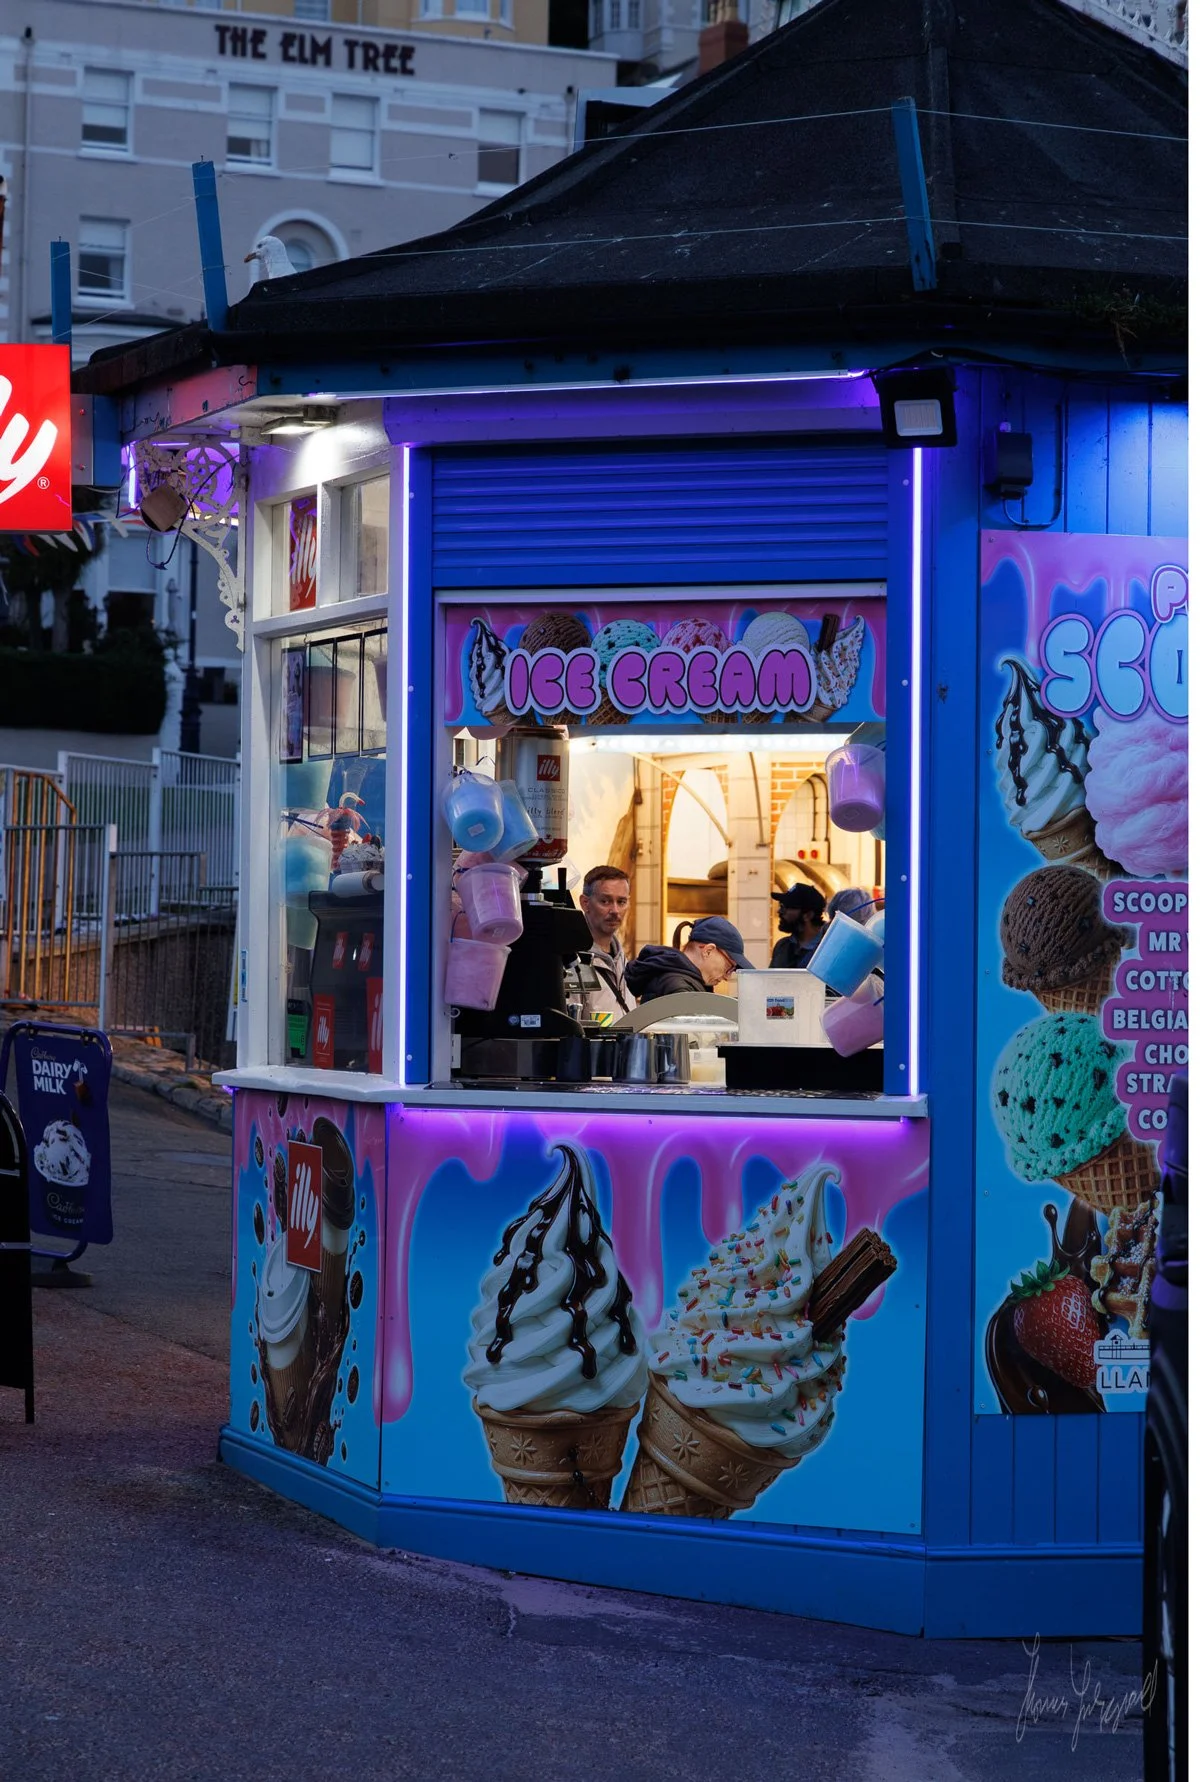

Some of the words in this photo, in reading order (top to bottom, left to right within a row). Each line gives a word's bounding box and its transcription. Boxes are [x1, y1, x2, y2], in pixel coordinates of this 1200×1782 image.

[214, 24, 267, 60] THE
[279, 31, 333, 68] ELM
[343, 38, 416, 76] TREE
[509, 652, 597, 710] ICE
[611, 648, 811, 708] CREAM
[539, 759, 560, 778] illy
[1113, 892, 1188, 913] SCOOP
[1148, 931, 1182, 952] MR
[1113, 1009, 1188, 1030] BELGIA
[1144, 1044, 1188, 1065] CHO
[32, 1059, 73, 1080] DAIRY
[33, 1075, 68, 1096] MILK
[1138, 1109, 1168, 1130] CO
[290, 1161, 319, 1250] illy
